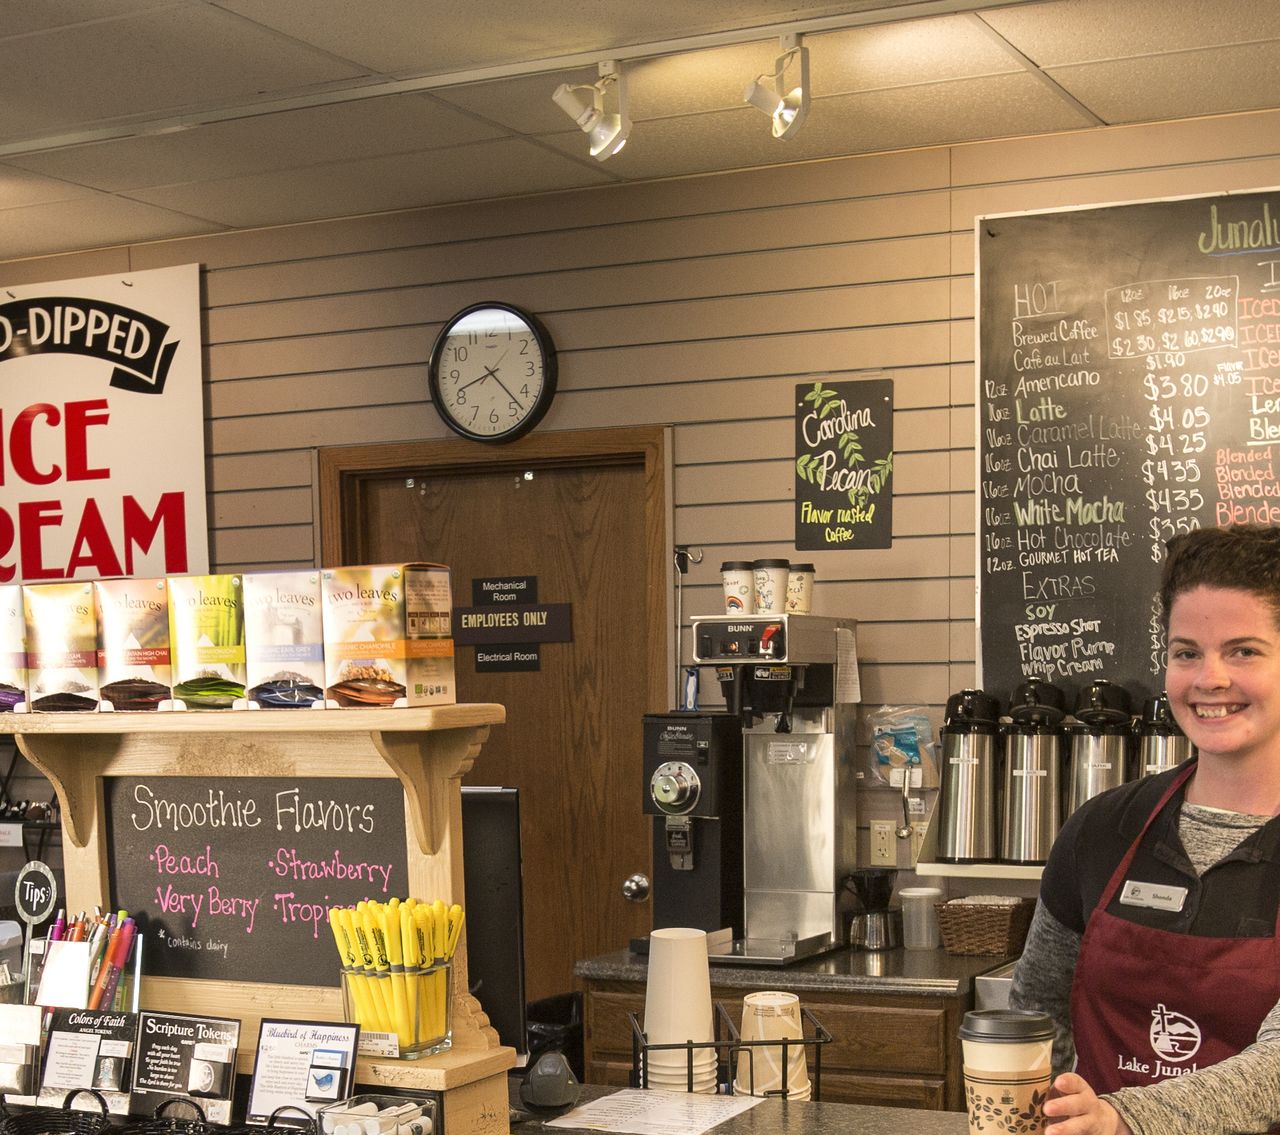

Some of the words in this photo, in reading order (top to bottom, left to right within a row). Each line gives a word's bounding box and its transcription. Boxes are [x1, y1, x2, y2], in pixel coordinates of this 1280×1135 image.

[1014, 280, 1063, 318] HOT
[1013, 321, 1057, 347] Brewed
[1059, 319, 1099, 341] Coffee
[1014, 370, 1100, 398] Americano
[1016, 397, 1067, 425] Latte
[1149, 404, 1210, 432] $4.05
[802, 399, 876, 447] Carolina
[1017, 414, 1093, 448] Caramel
[1100, 416, 1143, 441] Latte
[1018, 447, 1057, 473] Chai
[1069, 446, 1120, 469] Latte
[1215, 446, 1272, 466] Blended
[814, 450, 875, 495] Pecan
[1215, 464, 1275, 483] Blended
[1013, 471, 1083, 499] Mocha
[801, 502, 834, 524] Flavor
[837, 504, 875, 524] roasted
[1013, 498, 1065, 527] White
[1066, 495, 1126, 526] Mocha
[825, 527, 854, 543] Coffee
[1018, 529, 1046, 550] Hot
[1054, 525, 1133, 549] Chocolate
[1019, 548, 1069, 567] GOURMET
[1073, 548, 1093, 564] HOT
[1095, 548, 1119, 563] TEA
[356, 584, 398, 602] leaves
[483, 580, 526, 591] Mechanical
[493, 592, 516, 601] Room
[124, 594, 161, 612] leaves
[198, 590, 238, 609] leaves
[461, 612, 519, 629] EMPLOYEES
[523, 611, 548, 626] ONLY
[477, 652, 512, 662] Electrical
[513, 651, 537, 661] Room
[1019, 641, 1069, 662] Flavor
[131, 783, 261, 832] Smoothie
[275, 787, 375, 834] Flavors
[155, 843, 220, 876] Peach
[276, 848, 393, 892] Strawberry
[156, 885, 203, 928] Very
[209, 884, 260, 933] Berry
[168, 935, 202, 951] contains
[69, 1012, 93, 1025] Colors
[93, 1016, 103, 1029] of
[103, 1014, 127, 1027] Faith
[146, 1019, 194, 1038] Scripture
[196, 1023, 232, 1041] Tokens
[309, 1029, 350, 1042] Happiness
[1118, 1055, 1150, 1074] Lake
